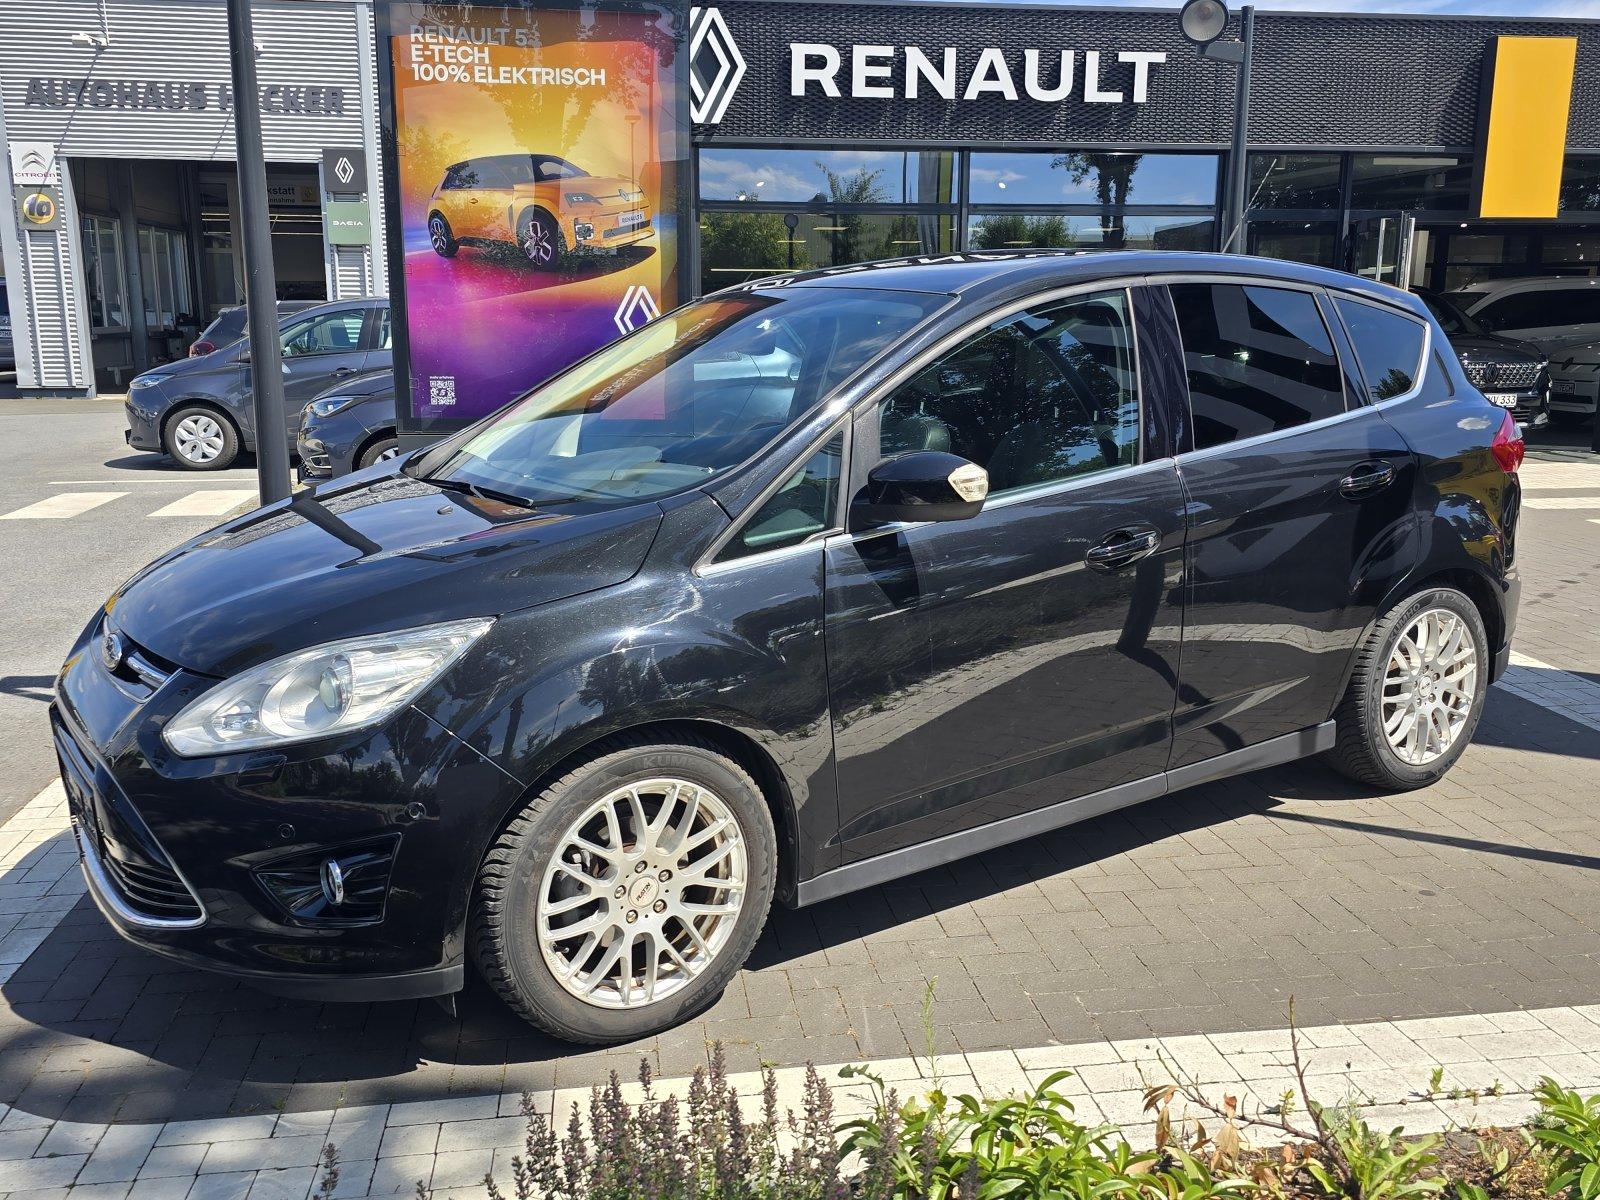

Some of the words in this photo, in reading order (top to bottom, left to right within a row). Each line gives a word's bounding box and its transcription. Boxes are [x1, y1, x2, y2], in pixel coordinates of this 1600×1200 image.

[410, 25, 510, 46] RENAULT
[515, 28, 528, 47] 5
[410, 44, 490, 64] E-TECH
[411, 63, 470, 83] 100%
[474, 66, 606, 86] ELEKTRISCH
[789, 43, 1167, 103] RENAULT
[26, 79, 207, 108] AUTOHAUS
[219, 84, 344, 113] HCKER
[267, 185, 295, 195] kstatt
[1500, 395, 1516, 405] 333
